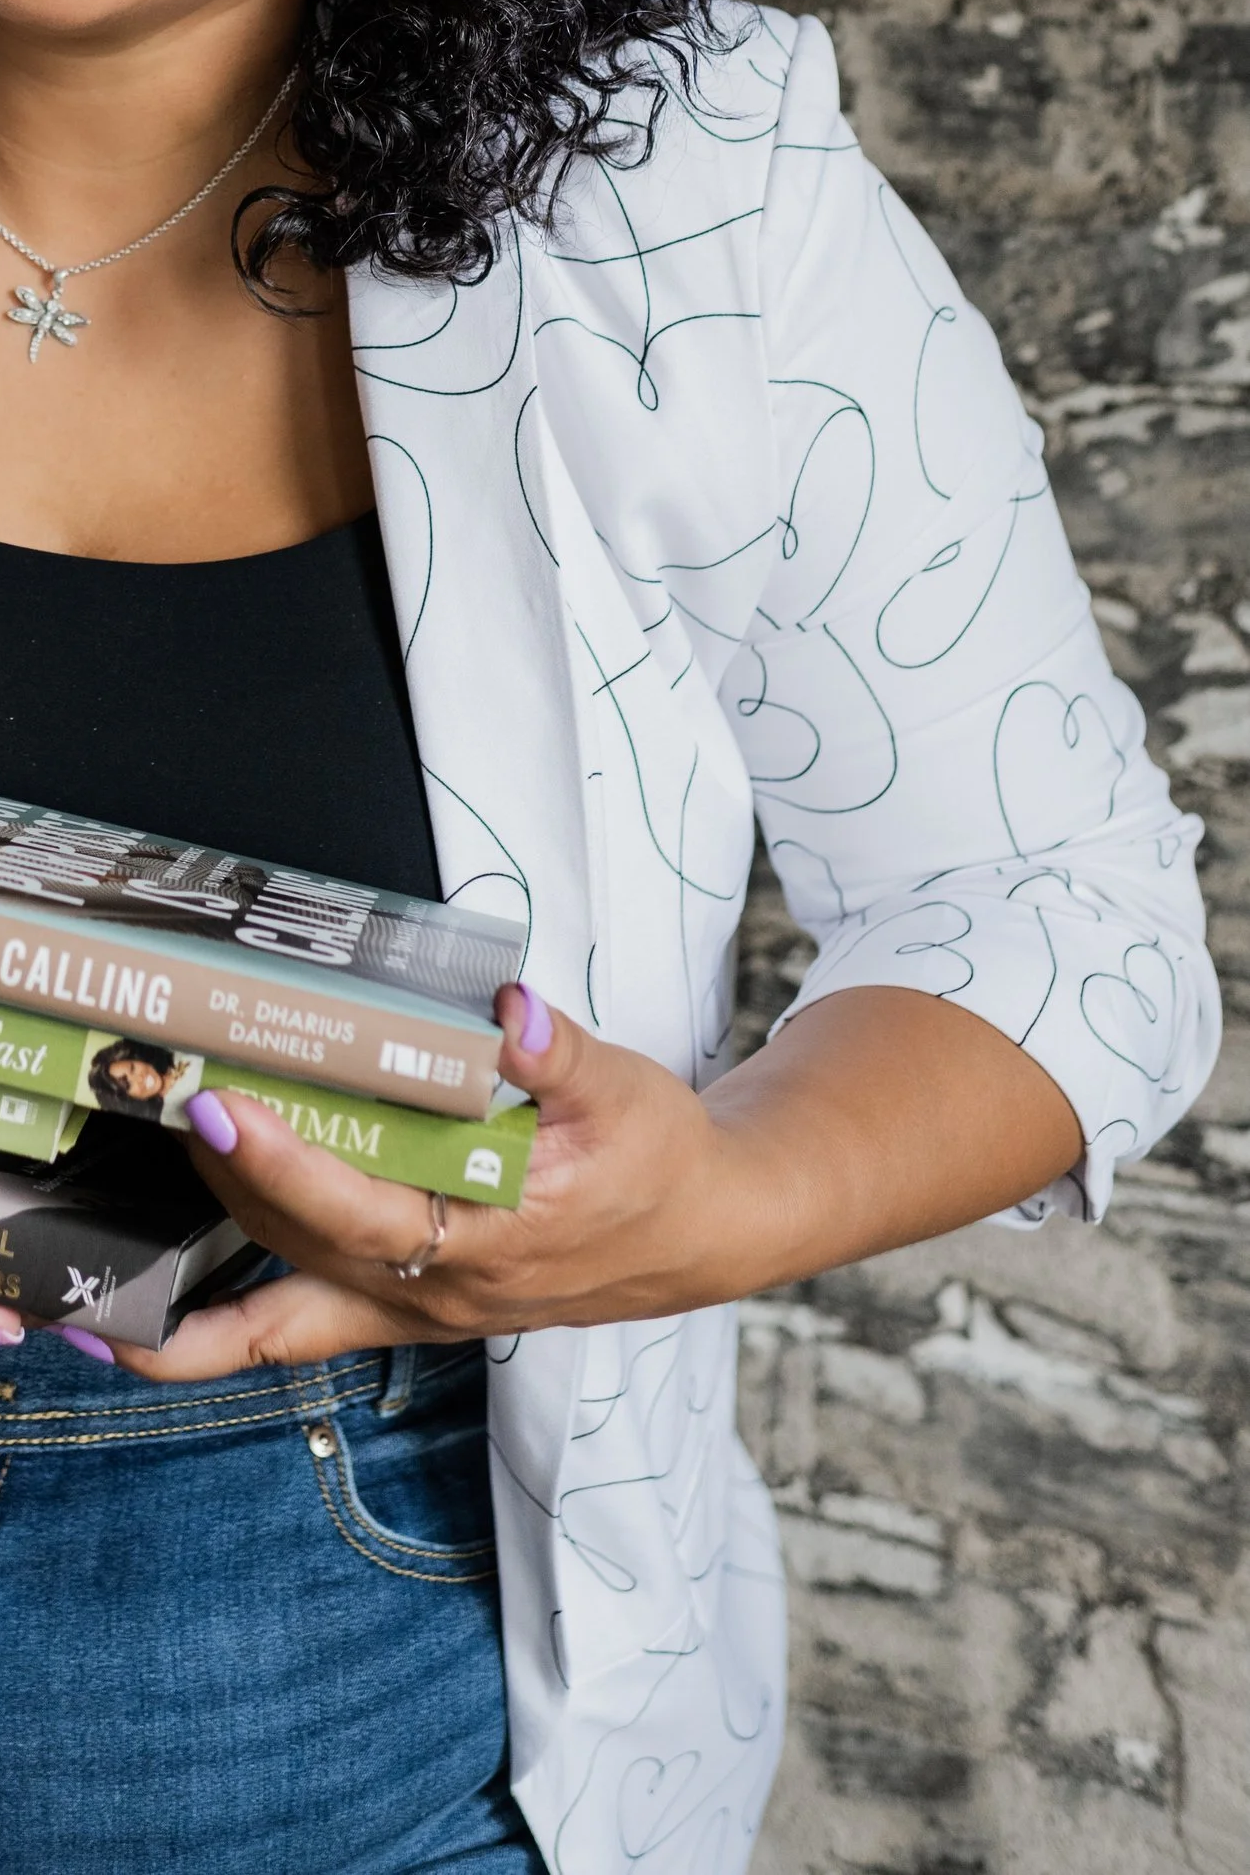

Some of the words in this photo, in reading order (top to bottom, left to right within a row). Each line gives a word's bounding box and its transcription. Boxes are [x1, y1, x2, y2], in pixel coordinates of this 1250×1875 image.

[121, 878, 240, 921] IS
[234, 870, 379, 966] CALLING
[0, 939, 172, 1025] CALLING
[209, 989, 244, 1018] DR.
[255, 999, 355, 1044] DHARIUS
[229, 1021, 326, 1064] DANIELS
